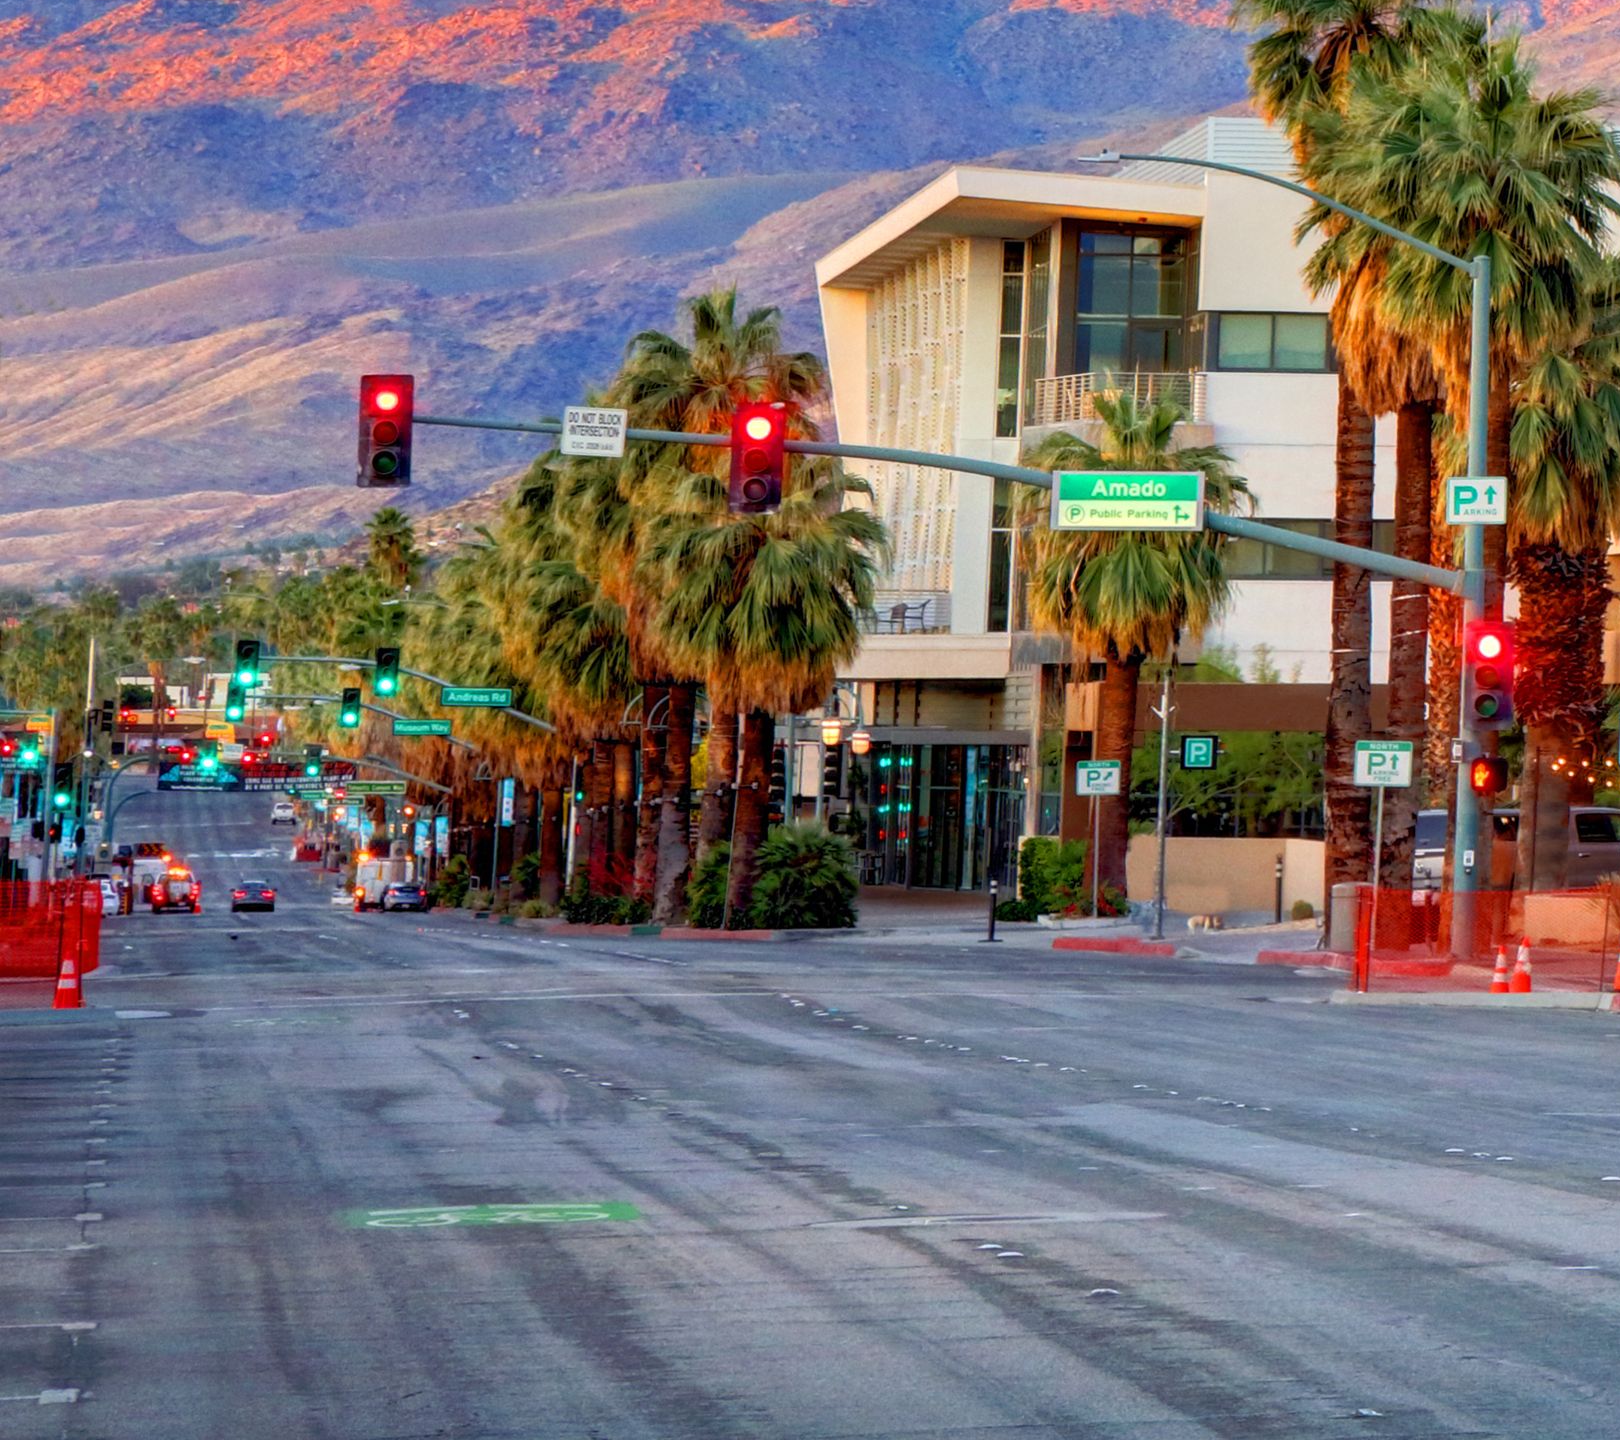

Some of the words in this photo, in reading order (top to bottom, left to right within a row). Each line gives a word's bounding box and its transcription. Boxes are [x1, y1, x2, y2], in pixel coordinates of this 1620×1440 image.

[568, 412, 580, 423] DO
[582, 413, 596, 423] NOT
[598, 414, 622, 425] BLOCK
[1090, 479, 1167, 497] Amado
[1090, 508, 1122, 519] Public
[1128, 509, 1168, 520] Parking
[448, 693, 489, 702] Andreas
[492, 693, 506, 702] Rd
[431, 724, 449, 732] Way
